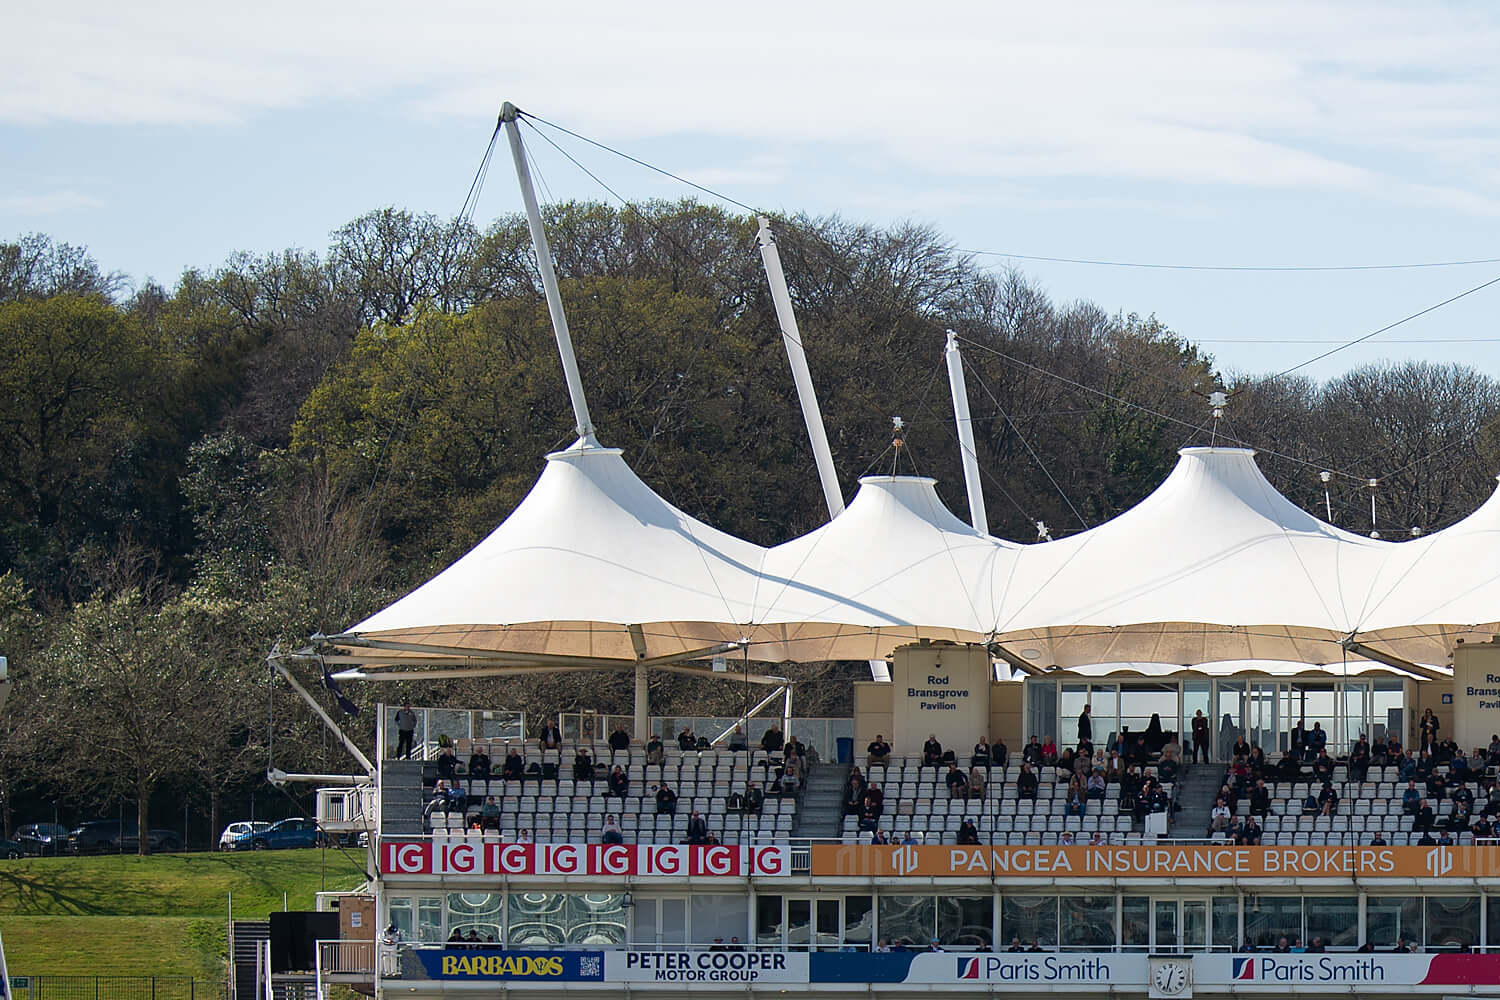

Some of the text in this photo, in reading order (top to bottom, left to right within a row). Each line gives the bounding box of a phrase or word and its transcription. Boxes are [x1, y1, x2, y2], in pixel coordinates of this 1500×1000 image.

[927, 675, 949, 685] Rod
[907, 688, 969, 699] Bransgrove
[920, 701, 956, 710] Pavilion
[390, 844, 423, 872] IG
[442, 844, 475, 873] IG
[493, 845, 526, 873] IG
[545, 845, 578, 873] IG
[596, 845, 629, 873] IG
[647, 846, 680, 874] IG
[698, 846, 731, 874] IG
[750, 846, 782, 874] IG
[950, 850, 1395, 872] PANGEA INSURANCE BROKERS
[441, 956, 564, 977] BARBADOS
[626, 952, 786, 971] PETER COOPER
[986, 956, 1110, 980] Paris Smith
[1261, 957, 1384, 981] Paris Smith
[655, 970, 759, 982] MOTOR GROUP
